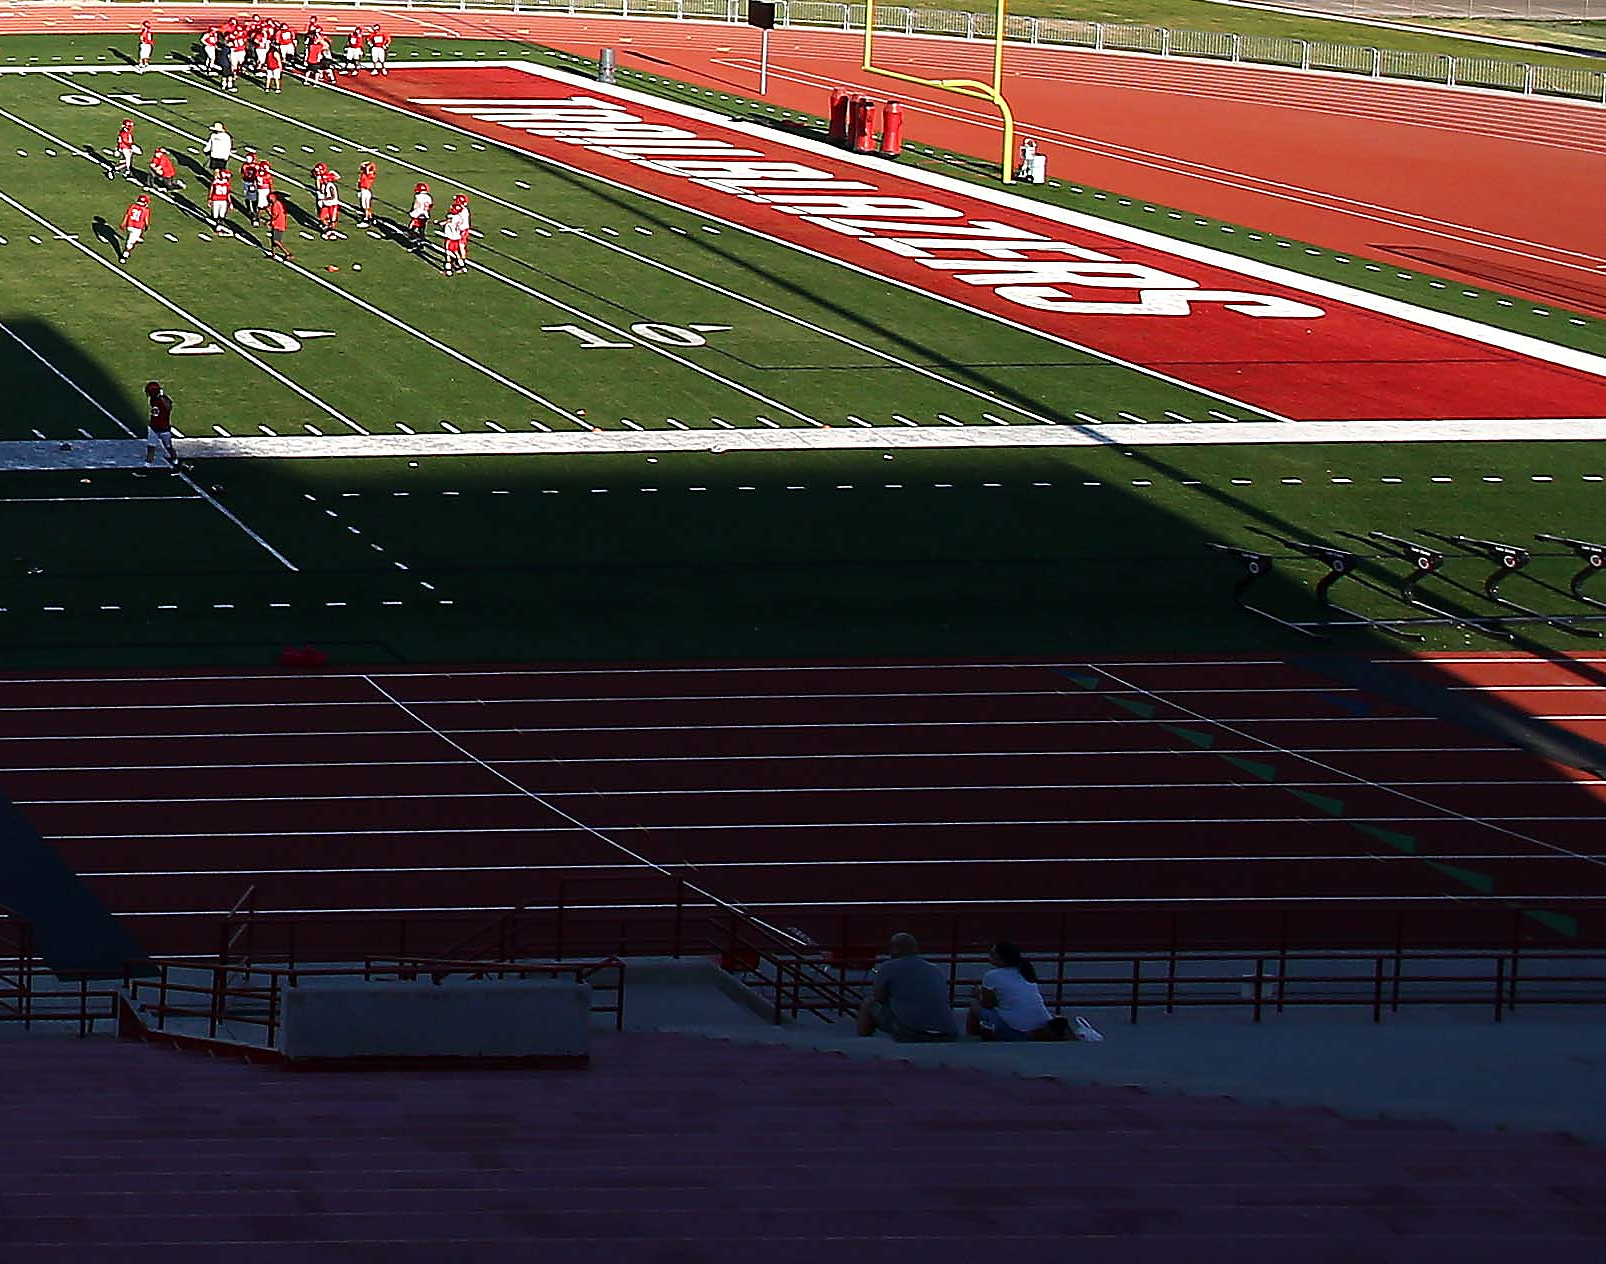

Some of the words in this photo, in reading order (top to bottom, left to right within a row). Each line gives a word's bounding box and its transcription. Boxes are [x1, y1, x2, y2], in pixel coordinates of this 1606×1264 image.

[406, 95, 1327, 319] TRAILBLAZERS
[148, 327, 307, 356] 20
[539, 321, 709, 350] 10
